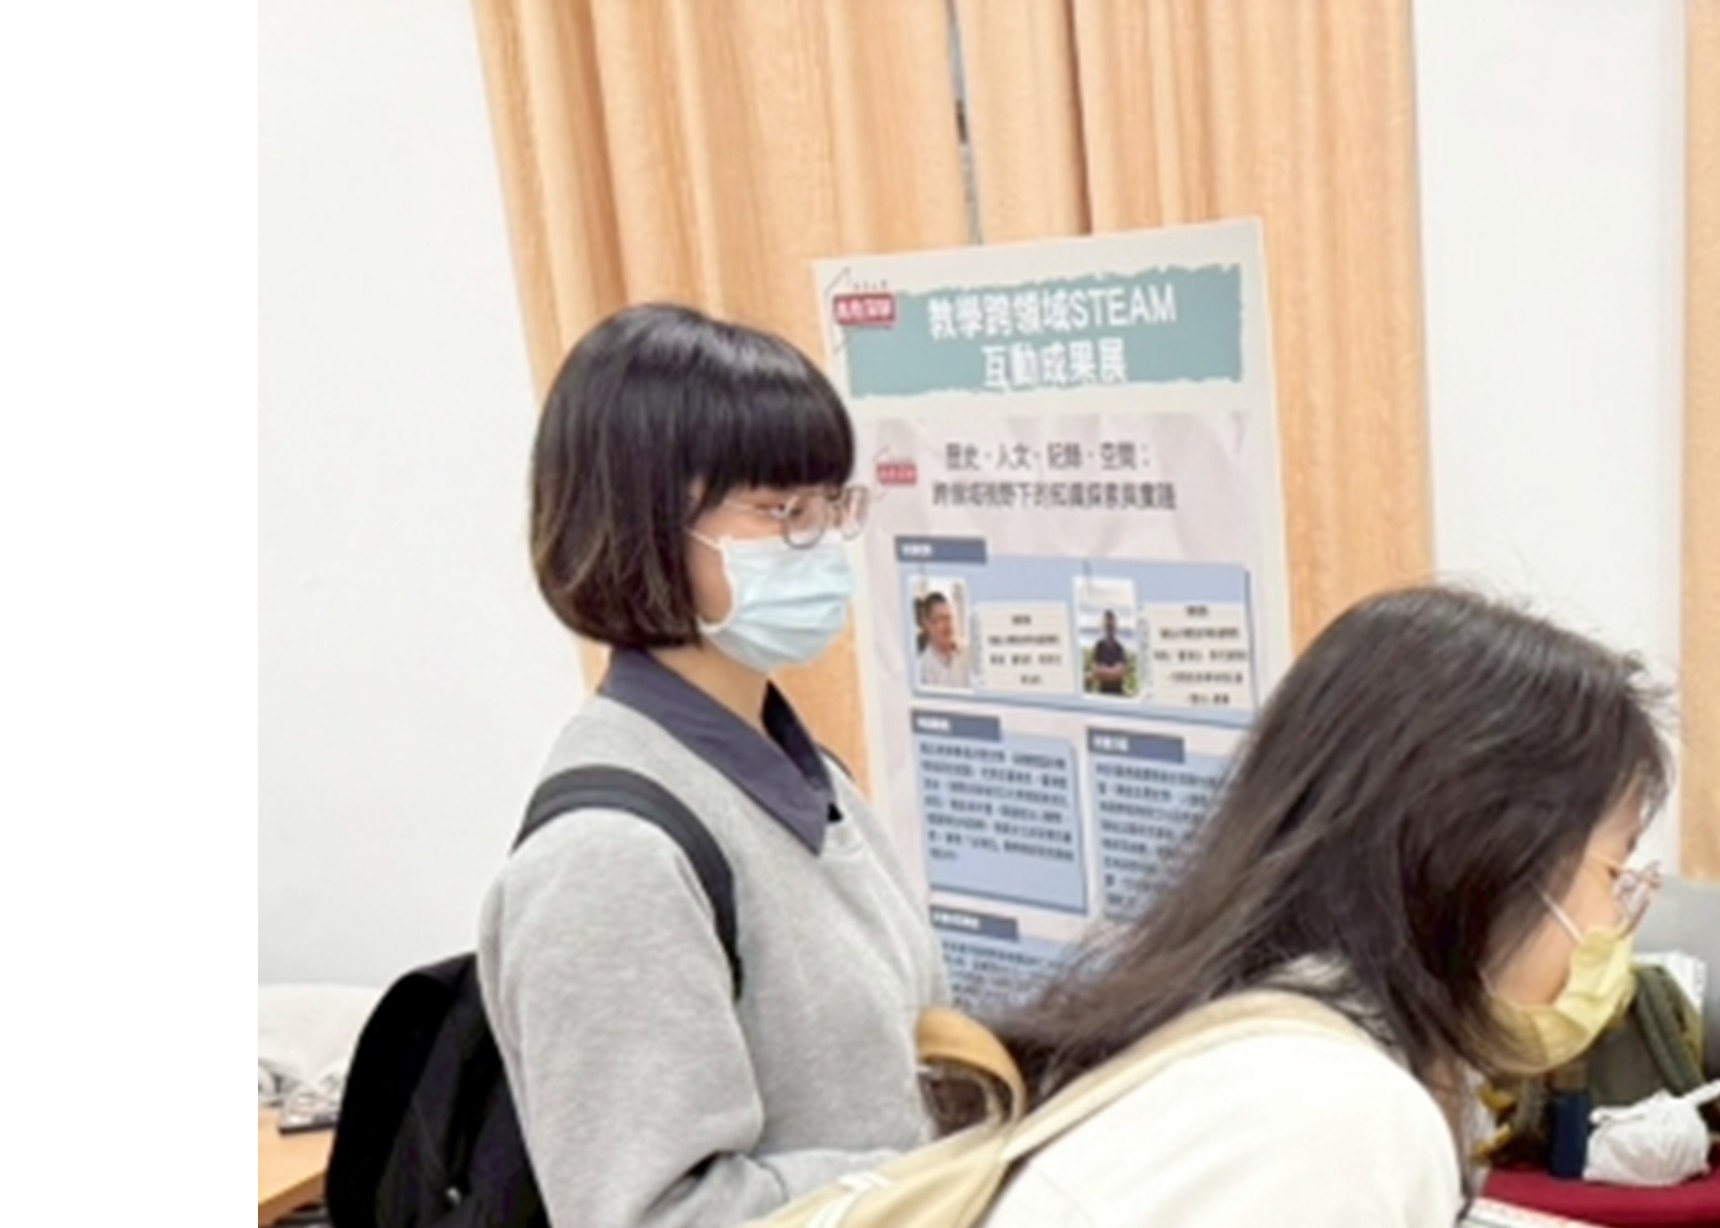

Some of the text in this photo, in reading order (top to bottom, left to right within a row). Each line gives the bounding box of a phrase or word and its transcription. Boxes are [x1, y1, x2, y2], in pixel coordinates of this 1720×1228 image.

[927, 283, 1177, 341] 教學跨領域STEAM
[981, 337, 1128, 389] 互動成果展
